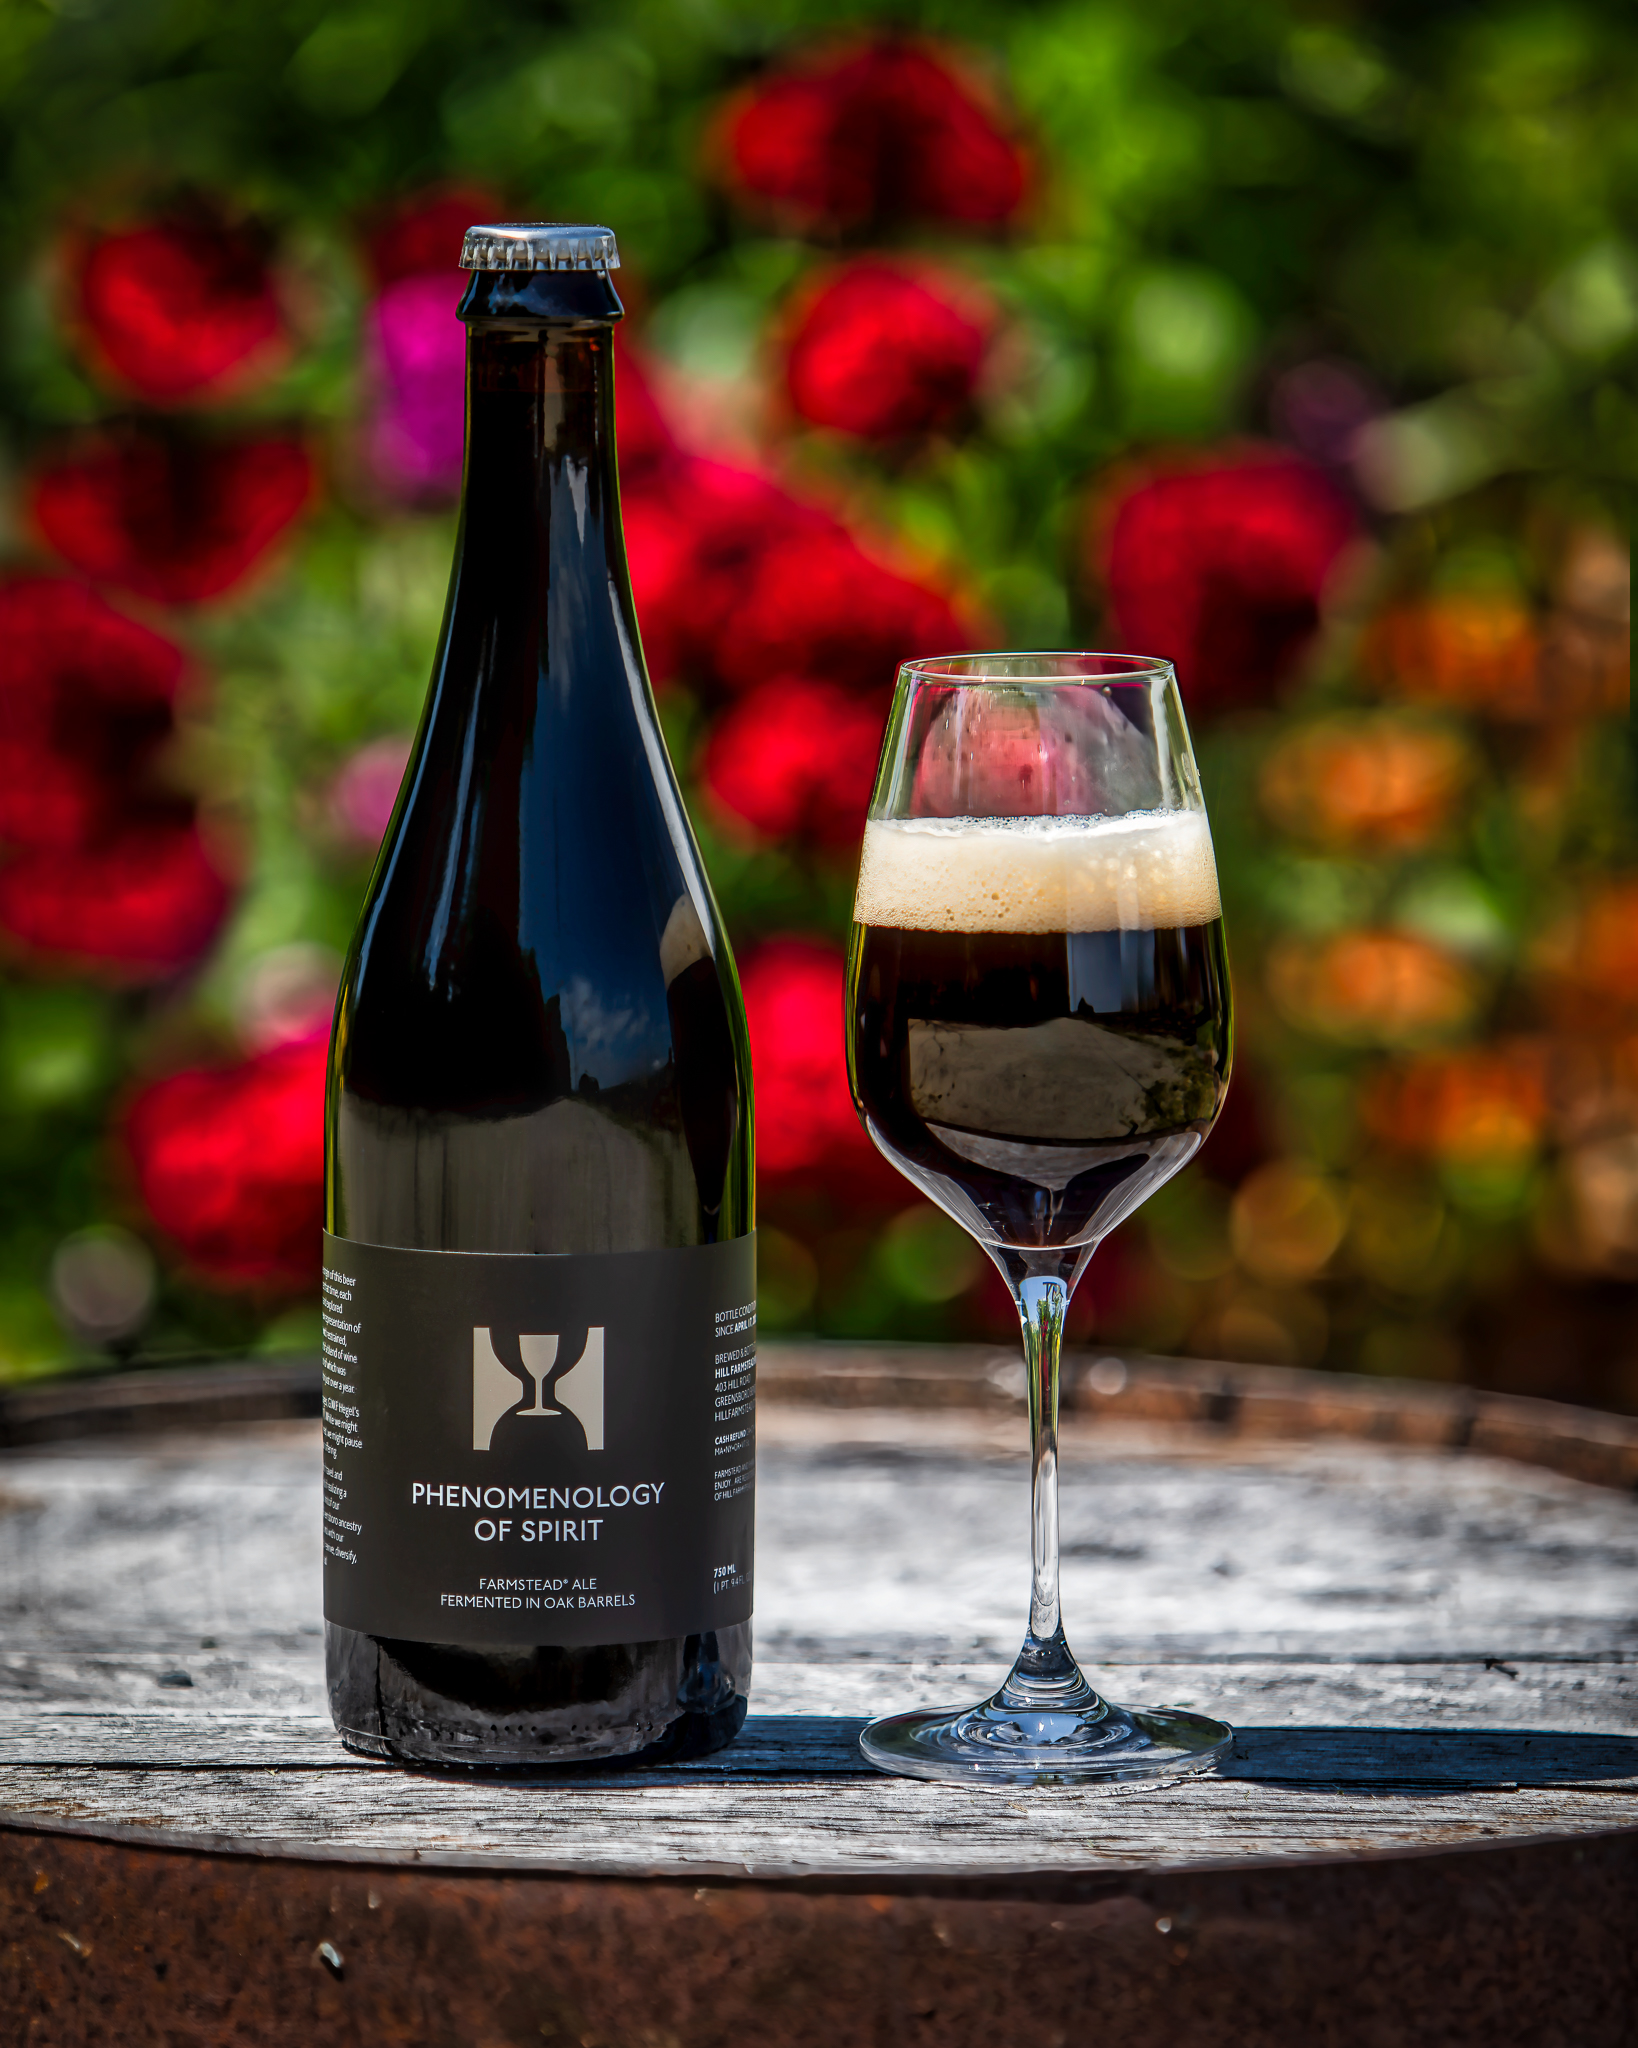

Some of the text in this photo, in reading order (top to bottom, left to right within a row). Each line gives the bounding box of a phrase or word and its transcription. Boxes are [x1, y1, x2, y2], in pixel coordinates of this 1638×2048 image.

[343, 1273, 356, 1287] beer
[339, 1290, 352, 1301] each
[715, 1308, 739, 1324] BOTTLE
[353, 1322, 362, 1333] of
[715, 1323, 734, 1338] SINCE
[344, 1352, 358, 1364] wine
[714, 1349, 740, 1365] BREWED
[714, 1366, 730, 1379] HILL
[714, 1381, 728, 1393] 403
[339, 1402, 360, 1419] Hegel's
[341, 1420, 359, 1434] might
[344, 1437, 363, 1449] pause
[714, 1433, 730, 1446] CASH
[412, 1481, 665, 1510] PHENOMENOLOGY
[338, 1518, 362, 1535] ancestry
[474, 1519, 604, 1542] OF SPIRIT
[713, 1563, 736, 1579] 750 ML
[571, 1577, 597, 1591] ALE
[440, 1594, 636, 1609] FERMENTED IN OAK BARRELS
